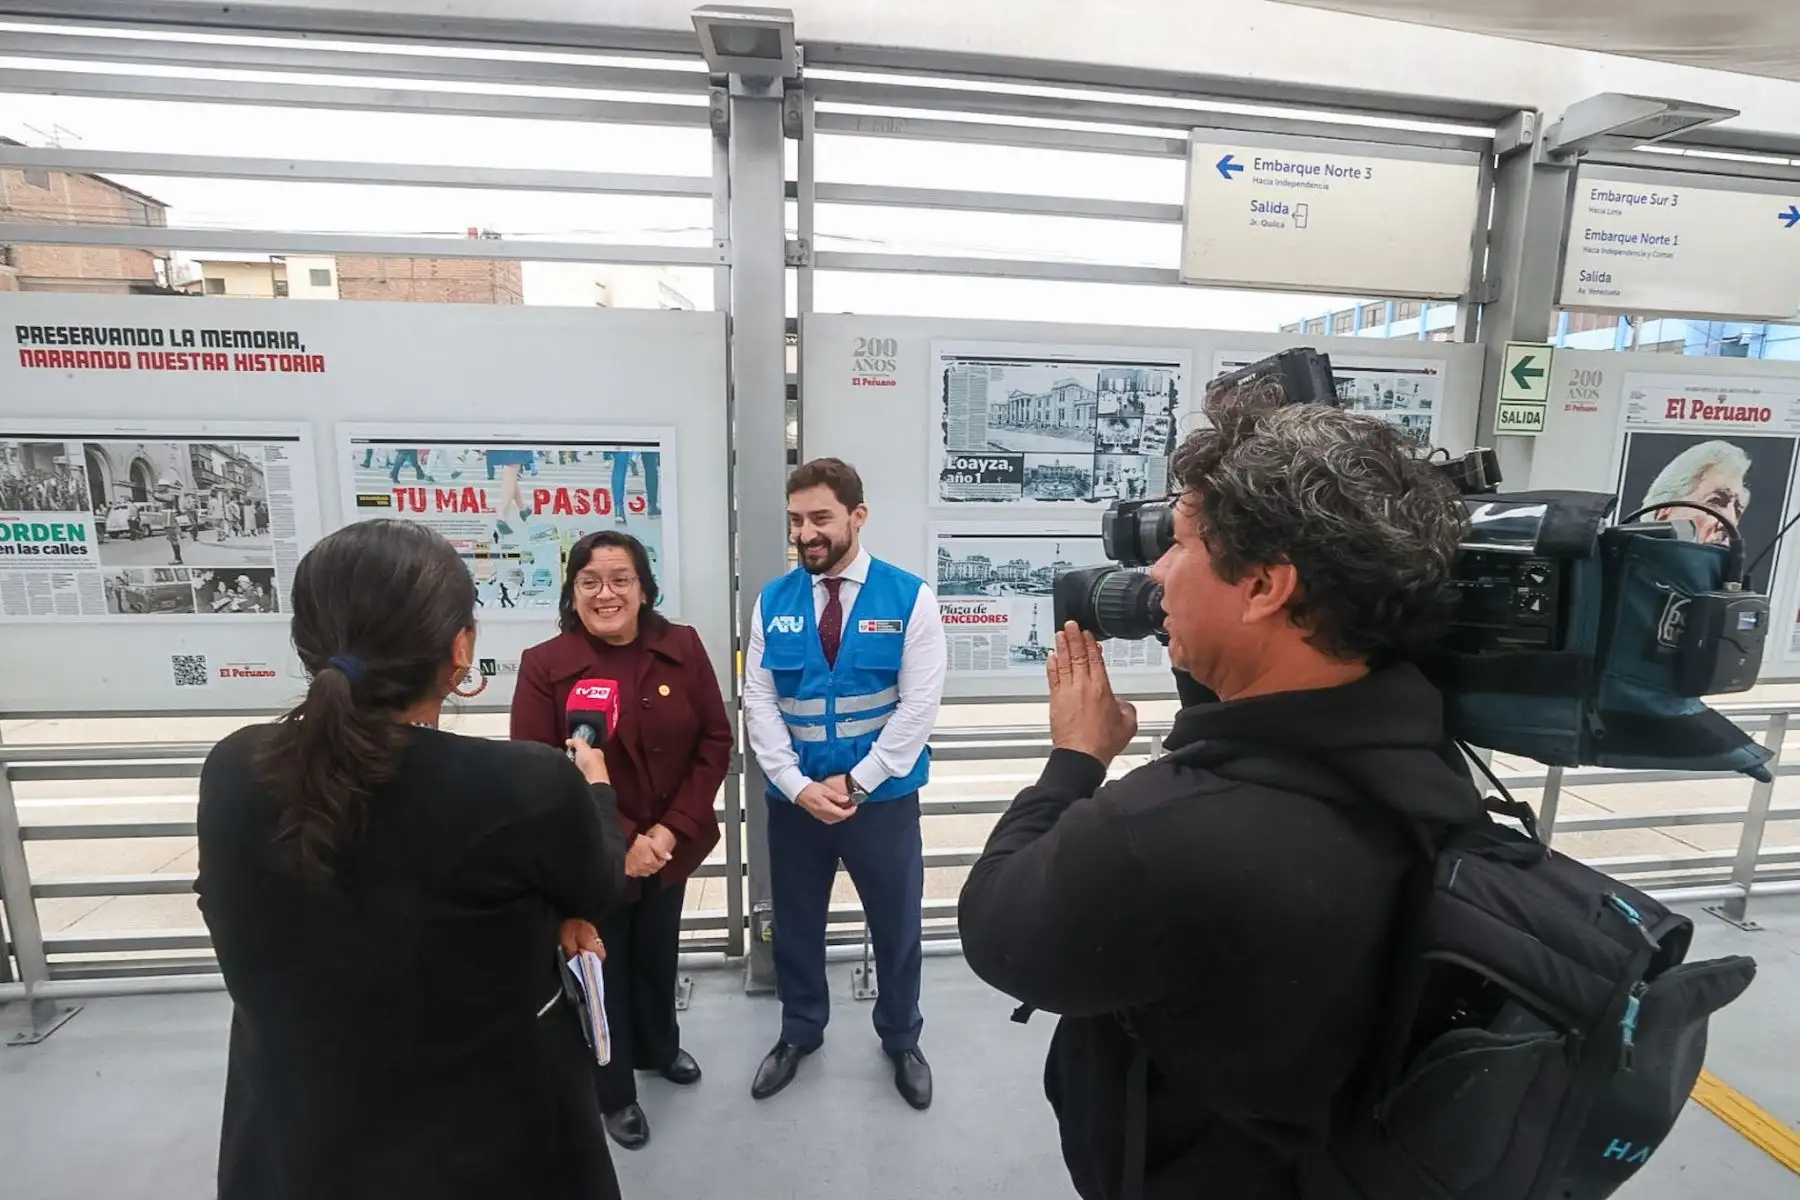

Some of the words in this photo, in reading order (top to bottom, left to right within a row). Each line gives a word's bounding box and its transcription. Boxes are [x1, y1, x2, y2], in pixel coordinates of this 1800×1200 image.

[1253, 157, 1321, 176] Embarque
[1324, 163, 1361, 179] Norte
[1364, 167, 1373, 180] 3
[1252, 177, 1273, 186] Hacia
[1275, 178, 1329, 190] Independencia
[1590, 188, 1648, 206] Embarque
[1649, 193, 1669, 206] Sur
[1671, 194, 1679, 206] 3
[1250, 199, 1289, 215] Salida
[1584, 228, 1638, 245] Embarque
[1640, 232, 1671, 246] Norte
[1672, 235, 1679, 246] 1
[1579, 269, 1612, 283] Salida
[15, 325, 165, 347] PRESERVANDO
[169, 328, 195, 347] LA
[200, 329, 306, 353] MEMORIA,
[852, 336, 898, 358] 200
[19, 348, 132, 370] NARRANDO
[136, 351, 229, 371] NUESTRA
[233, 353, 326, 373] HISTORIA
[851, 355, 897, 373] AÑOS
[862, 377, 897, 387] Peruano
[1568, 368, 1604, 388] 200
[1500, 409, 1542, 426] SALIDA
[1664, 397, 1687, 420] El
[1689, 398, 1772, 423] Peruano
[946, 471, 973, 484] año
[974, 472, 981, 484] 1
[392, 487, 427, 513] TU
[435, 486, 497, 514] MAL
[0, 522, 87, 542] ORDEN
[17, 542, 40, 555] las
[42, 543, 89, 556] calles
[939, 603, 971, 615] Plaza
[973, 602, 988, 614] de
[767, 615, 805, 634] ATU
[219, 668, 231, 678] El
[233, 668, 276, 678] Peruano
[480, 660, 519, 675] MUSE
